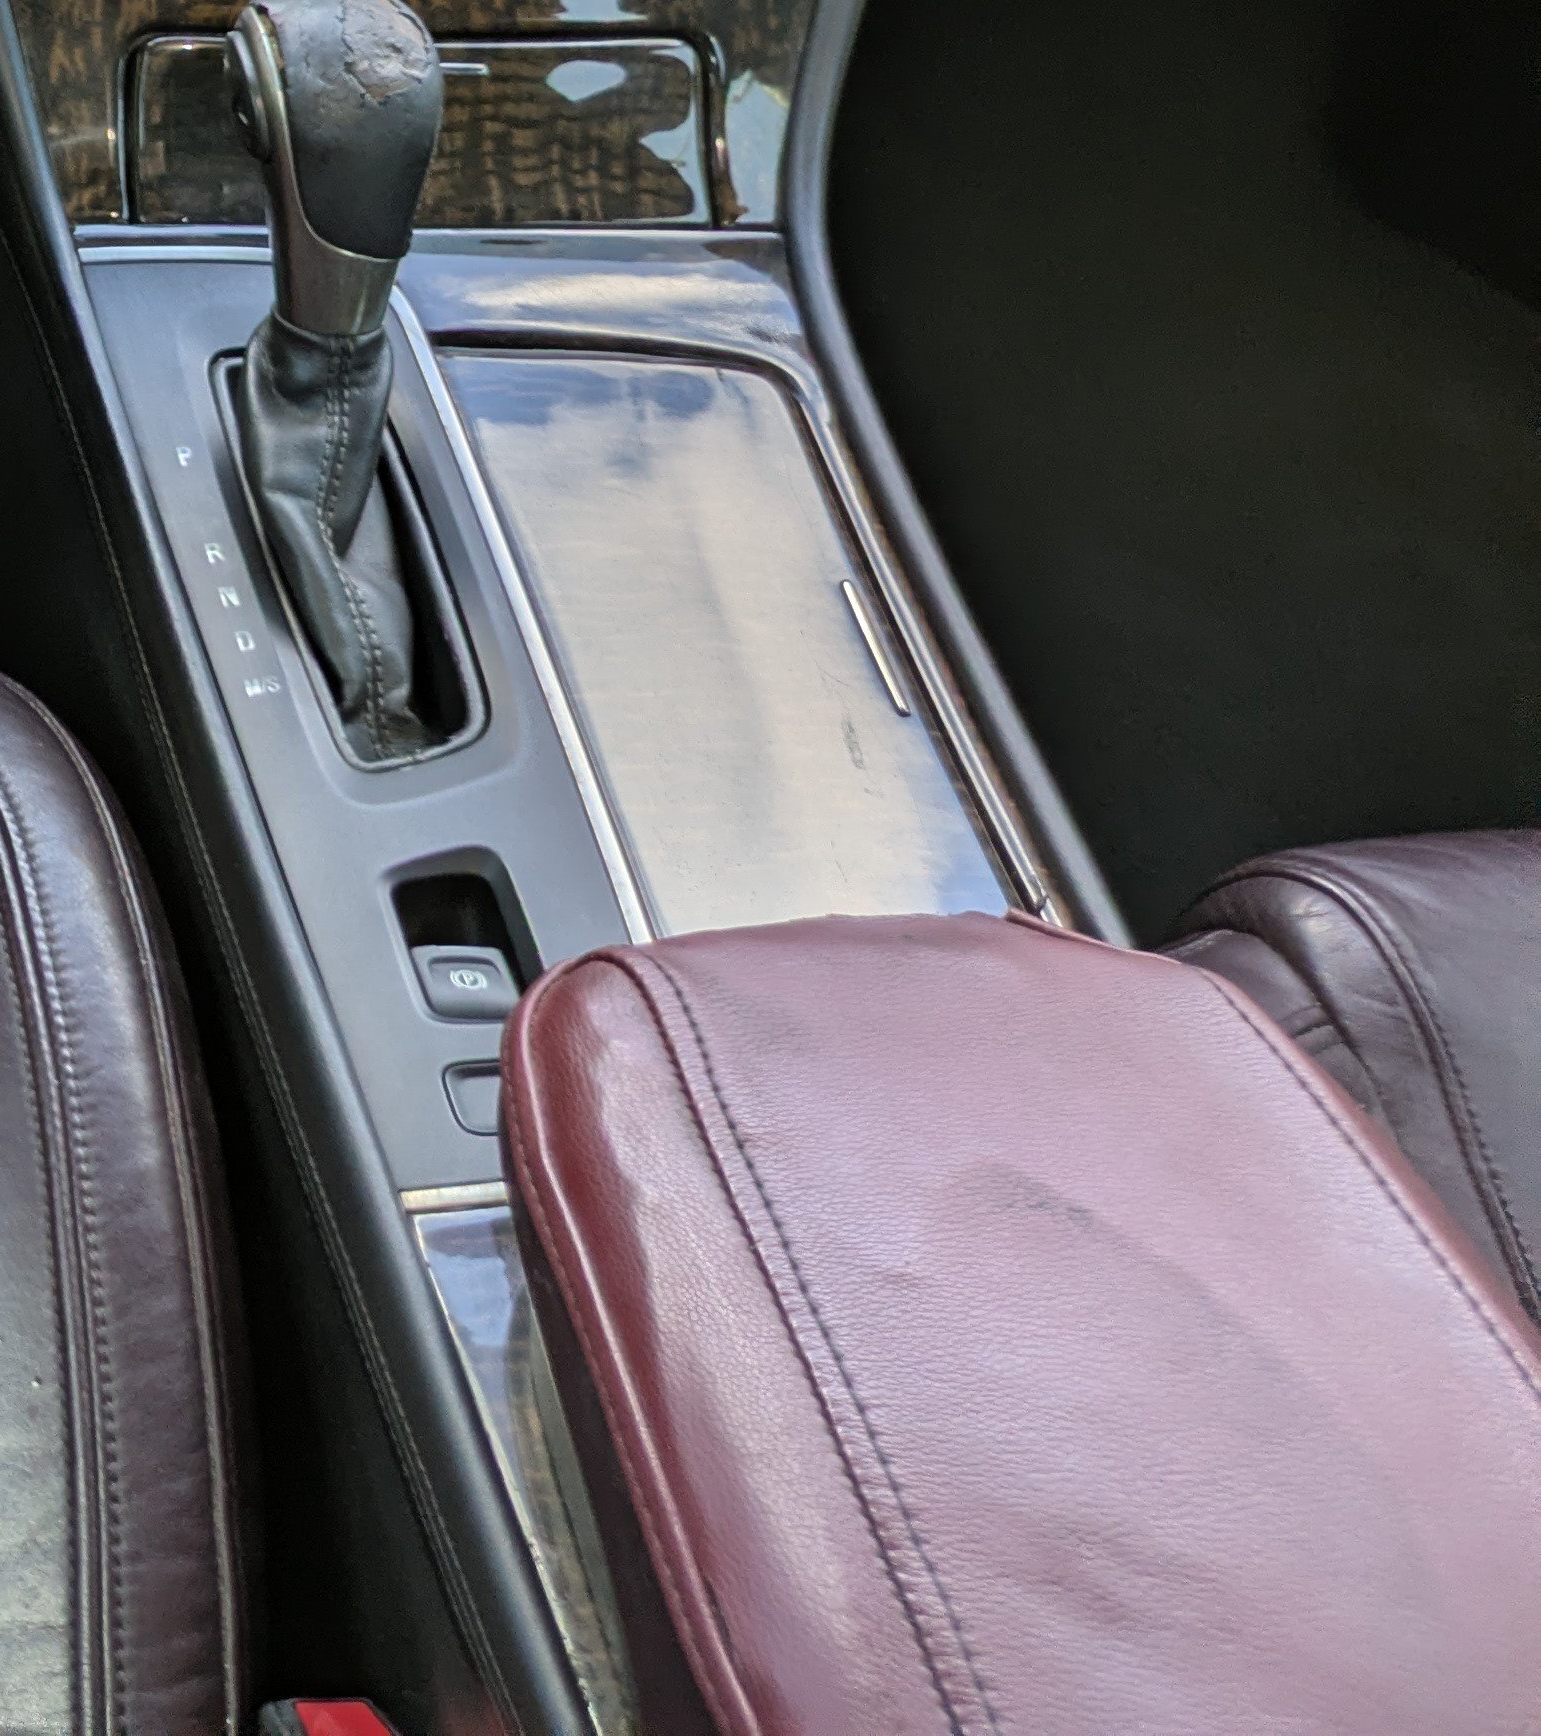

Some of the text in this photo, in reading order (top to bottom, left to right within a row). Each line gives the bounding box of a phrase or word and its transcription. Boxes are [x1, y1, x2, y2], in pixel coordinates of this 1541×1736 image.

[176, 446, 193, 467] P
[204, 542, 226, 564] R
[217, 586, 241, 608] N
[234, 630, 256, 652] D
